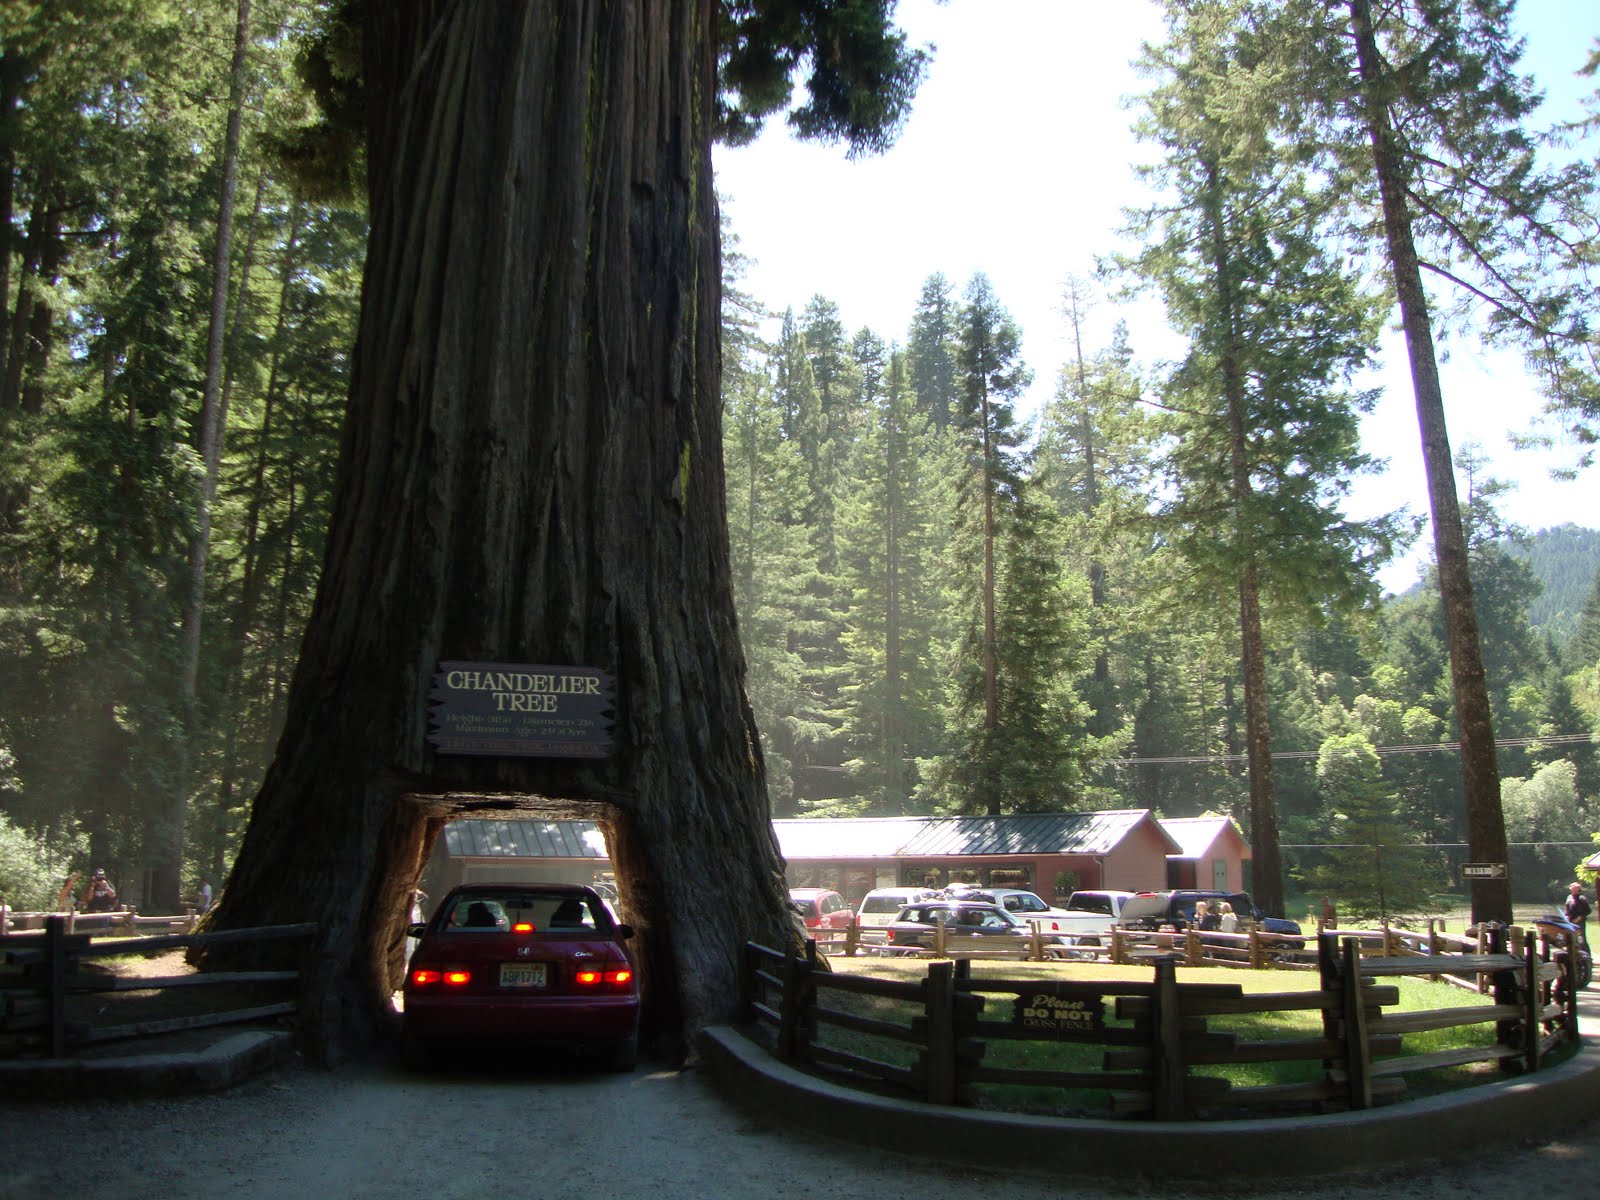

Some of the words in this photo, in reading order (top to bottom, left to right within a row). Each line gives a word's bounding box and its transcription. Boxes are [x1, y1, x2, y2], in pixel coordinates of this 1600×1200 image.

[447, 671, 601, 695] CHANDELIER
[492, 692, 557, 712] TREE
[455, 724, 509, 734] Maximum
[1032, 994, 1085, 1010] Please
[1023, 1007, 1049, 1018] DO
[1054, 1009, 1094, 1021] NOT
[1023, 1018, 1057, 1029] CROSS
[1060, 1019, 1094, 1030] FENCE
